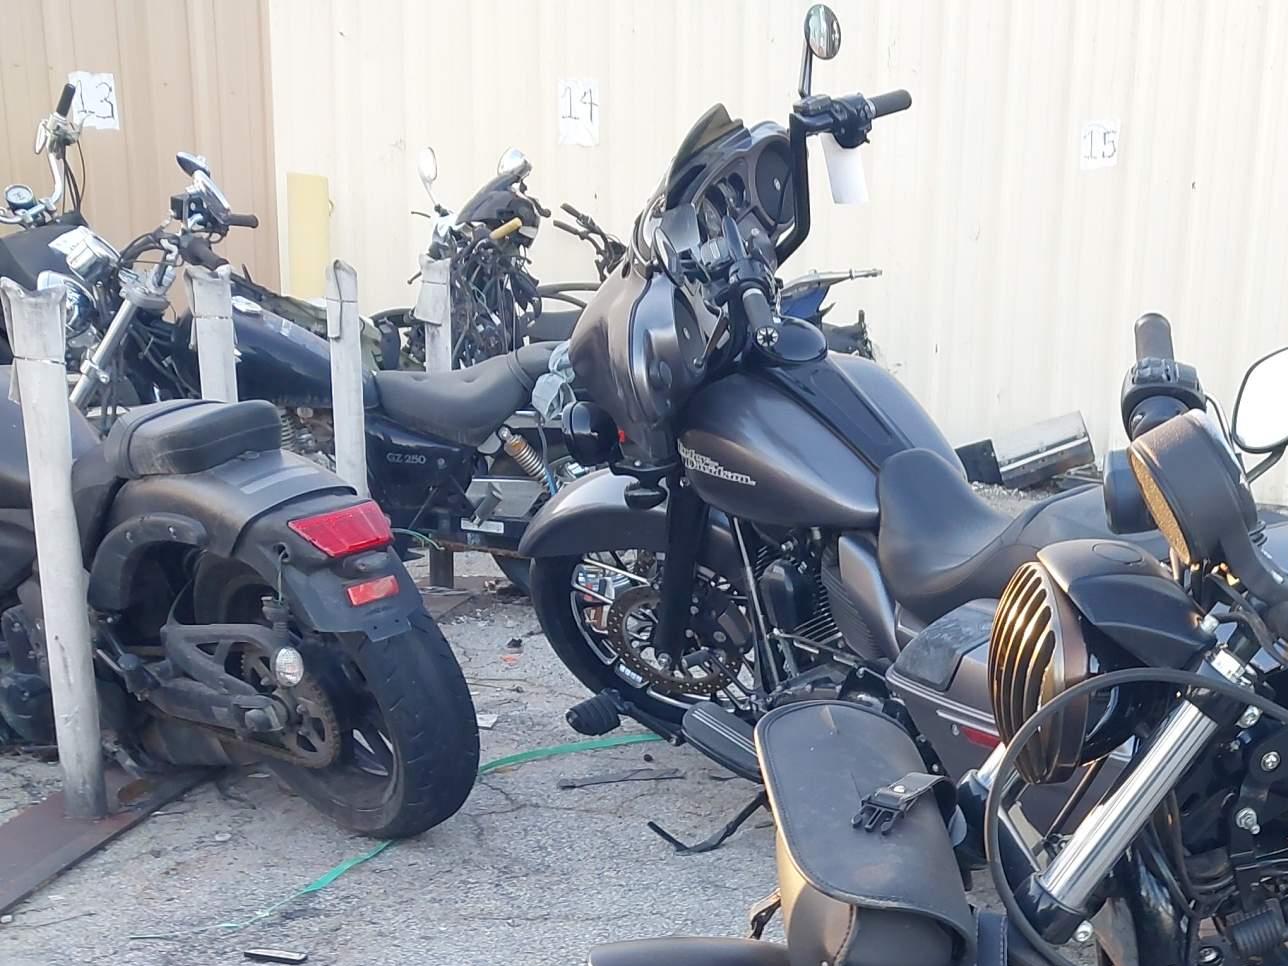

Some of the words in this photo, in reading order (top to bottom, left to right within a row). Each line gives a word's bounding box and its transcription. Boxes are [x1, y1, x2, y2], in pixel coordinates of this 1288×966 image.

[76, 79, 115, 120] 13
[560, 86, 600, 123] 14
[1083, 129, 1118, 160] 15
[386, 452, 403, 464] GZ
[404, 454, 427, 465] 250
